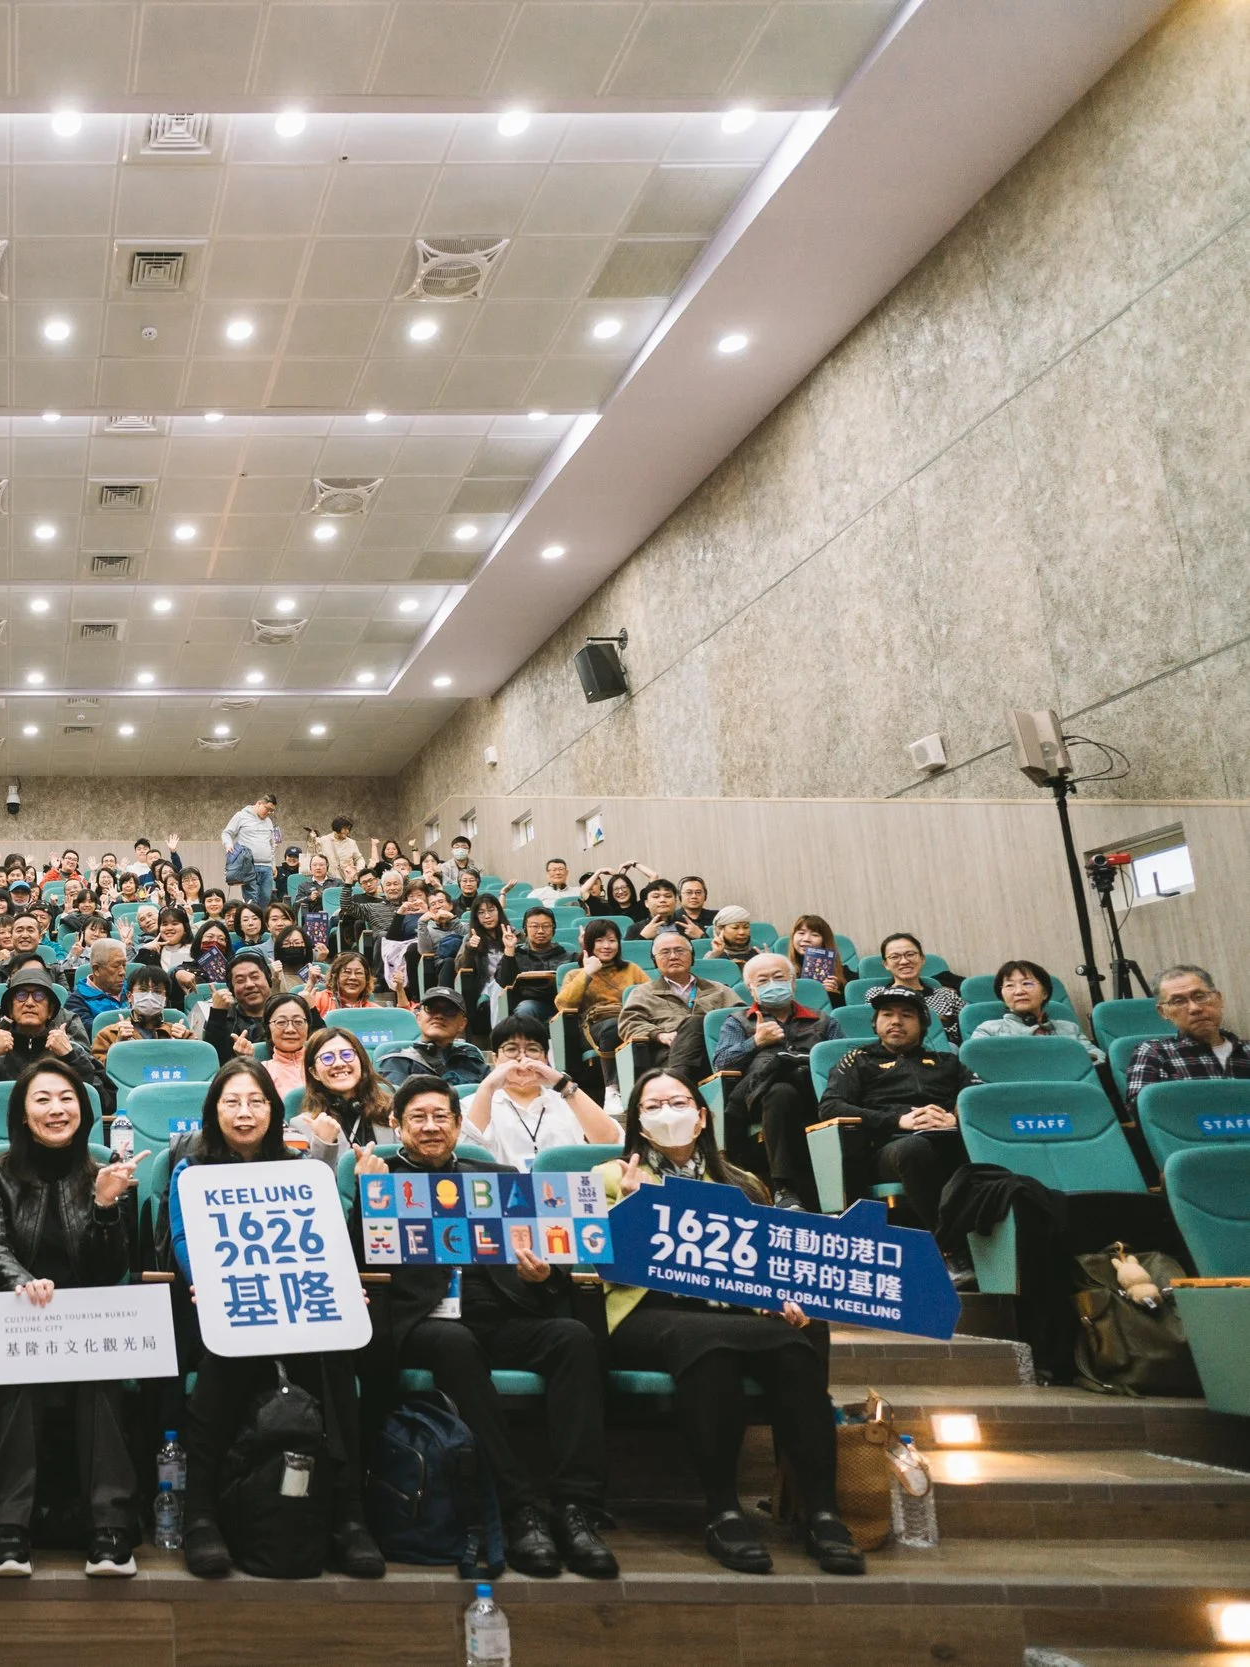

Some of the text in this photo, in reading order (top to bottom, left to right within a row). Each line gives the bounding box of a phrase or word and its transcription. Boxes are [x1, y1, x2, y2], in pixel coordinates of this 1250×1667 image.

[150, 1070, 182, 1080] 保留席
[1016, 1118, 1066, 1130] STAFF
[204, 1184, 313, 1206] KEELUNG
[767, 1223, 903, 1269] 流動的港口
[767, 1256, 903, 1302] 世界的基隆
[221, 1270, 343, 1328] 基隆
[648, 1266, 902, 1320] FLOWING HARBOR GLOBAL KEELUNG
[4, 1310, 138, 1324] CULTURE AND TOURISM BUREAU
[5, 1325, 42, 1334] KEELUNG
[6, 1335, 156, 1357] 基隆市文化觀光局
